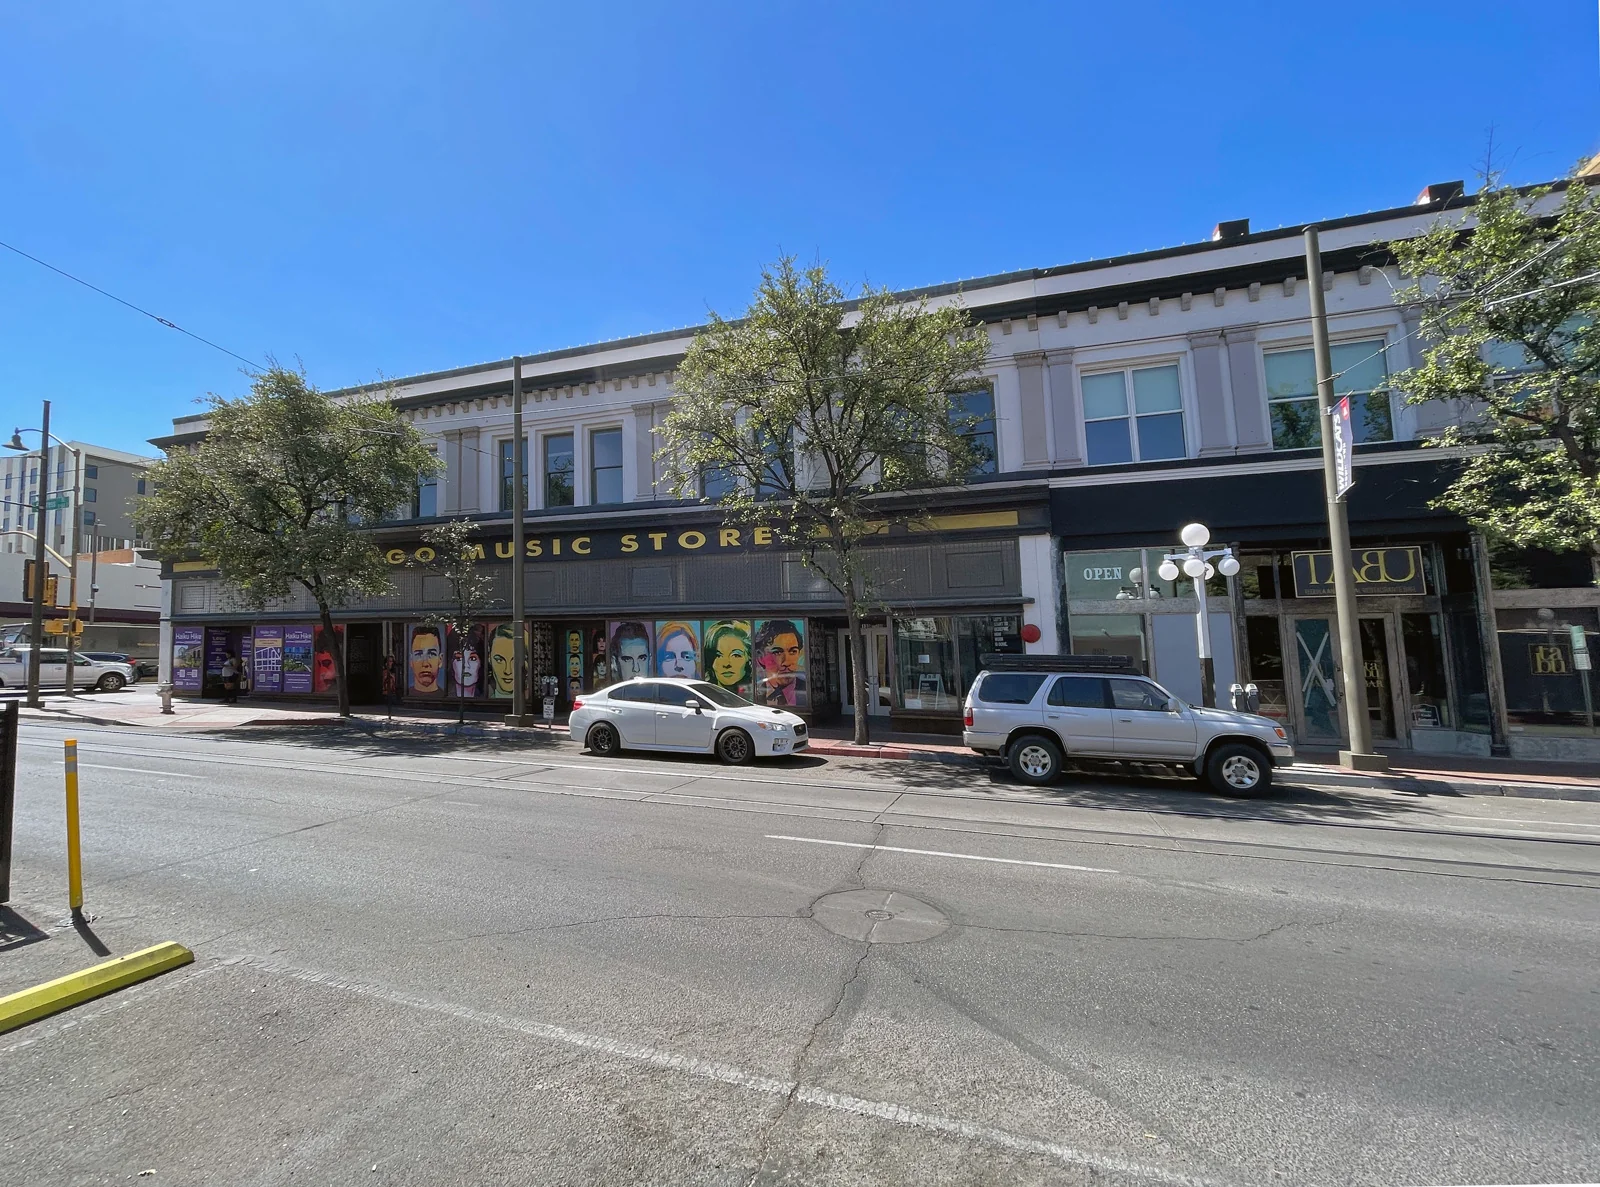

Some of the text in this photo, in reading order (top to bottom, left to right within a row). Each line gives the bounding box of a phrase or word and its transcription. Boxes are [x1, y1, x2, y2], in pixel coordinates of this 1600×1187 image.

[1332, 413, 1345, 492] WILDCATS
[461, 536, 591, 561] MUSIC
[620, 527, 773, 552] STORE
[1083, 567, 1122, 581] OPEN
